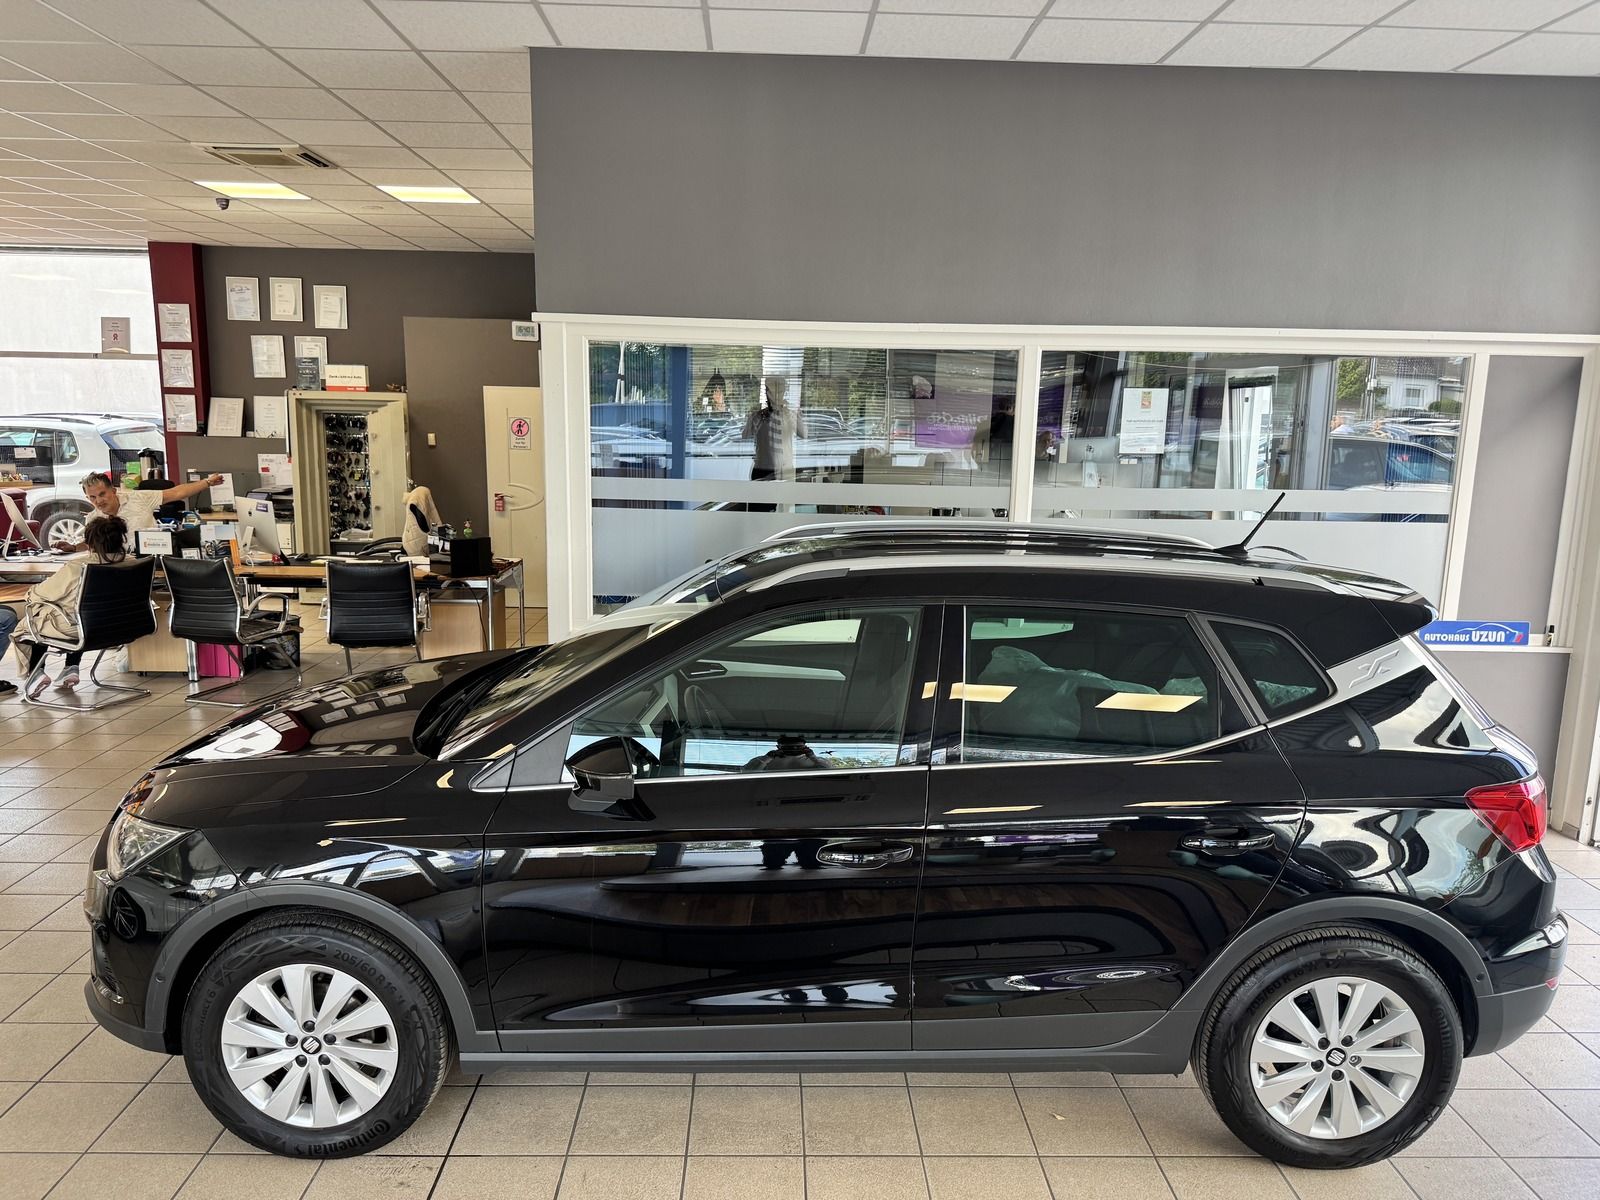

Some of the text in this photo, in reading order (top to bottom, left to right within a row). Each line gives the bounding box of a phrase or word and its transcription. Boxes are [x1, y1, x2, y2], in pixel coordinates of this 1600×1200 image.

[1424, 630, 1506, 643] AUTOHAUS UZUN
[333, 949, 377, 977] 205/60
[376, 973, 386, 986] R
[1246, 981, 1281, 1016] 205/60
[309, 1119, 391, 1156] Continental
